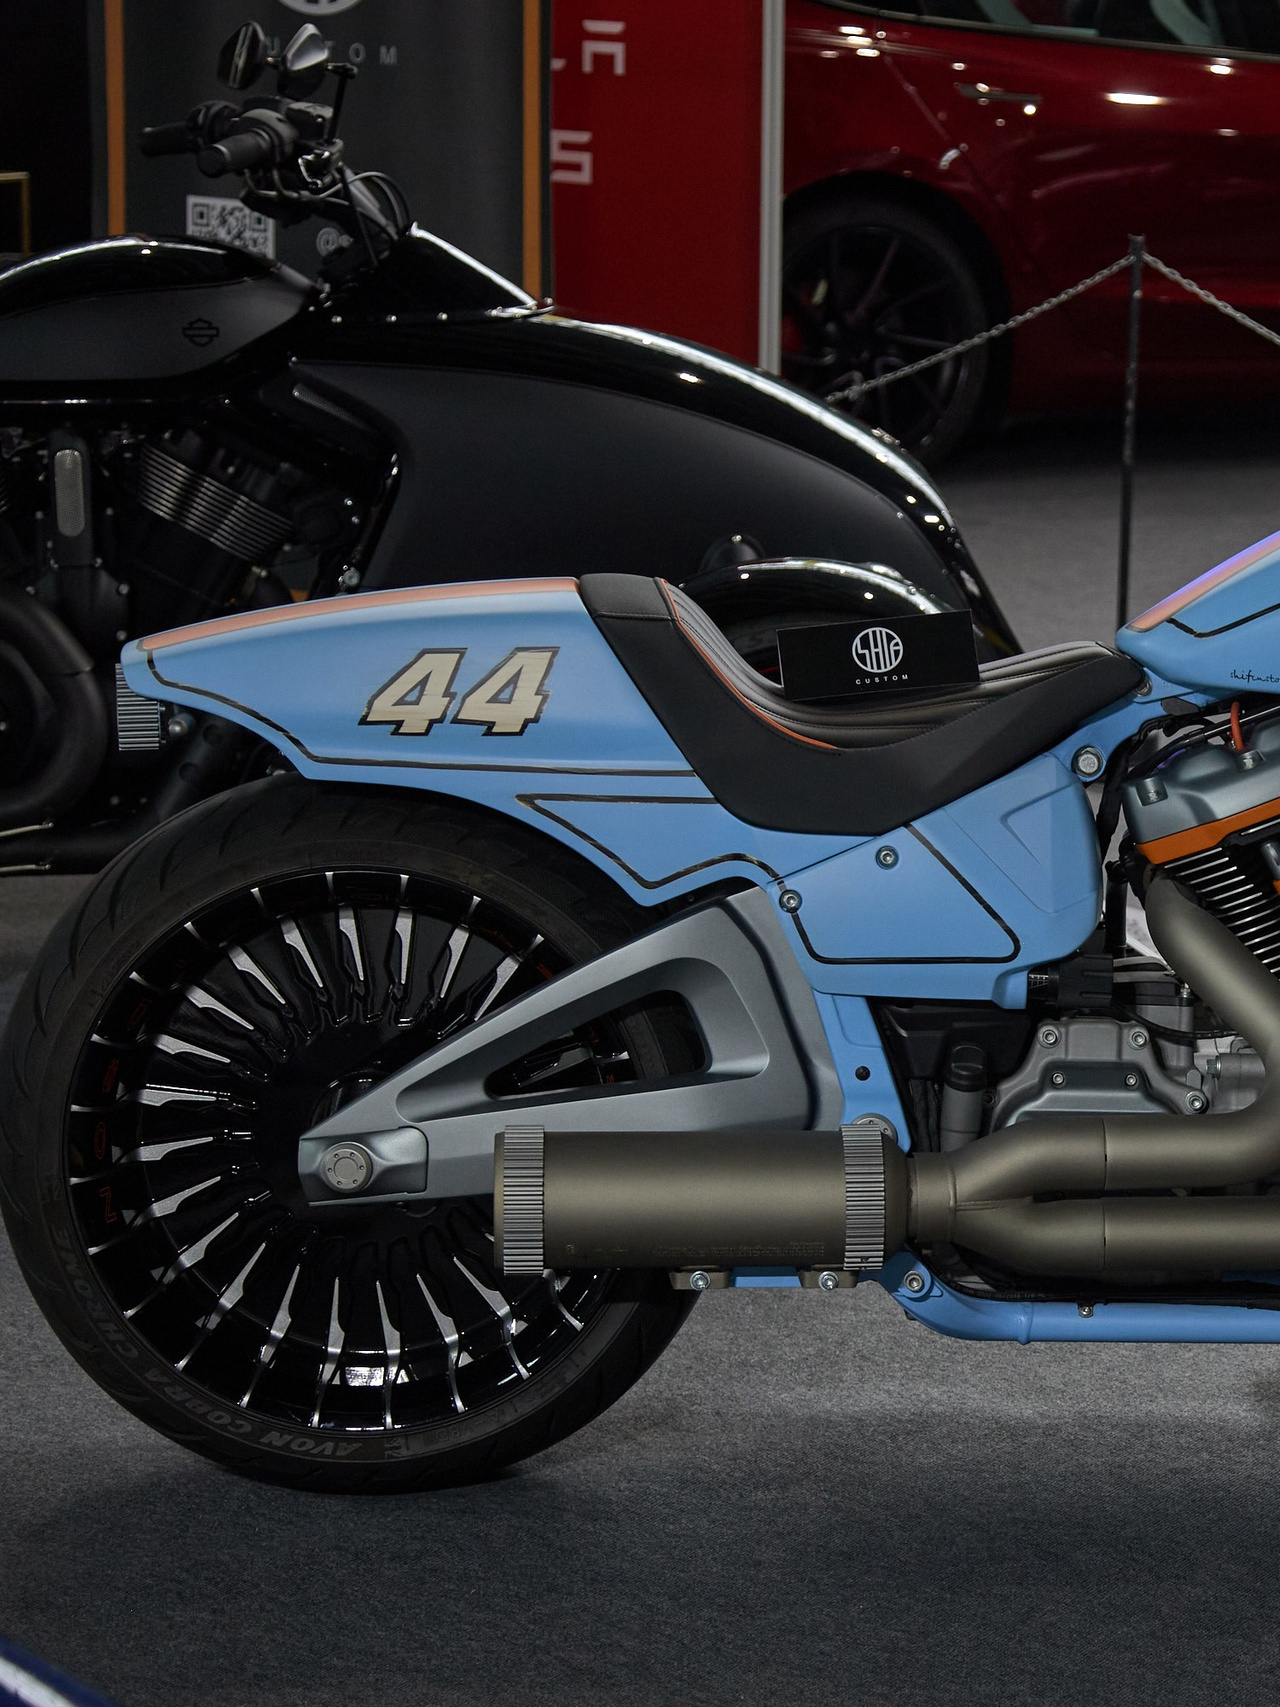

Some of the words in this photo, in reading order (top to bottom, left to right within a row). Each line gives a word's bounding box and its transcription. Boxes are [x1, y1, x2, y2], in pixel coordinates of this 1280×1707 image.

[357, 646, 561, 736] 44
[855, 674, 909, 685] CUSTOM
[259, 1430, 363, 1456] AVON
